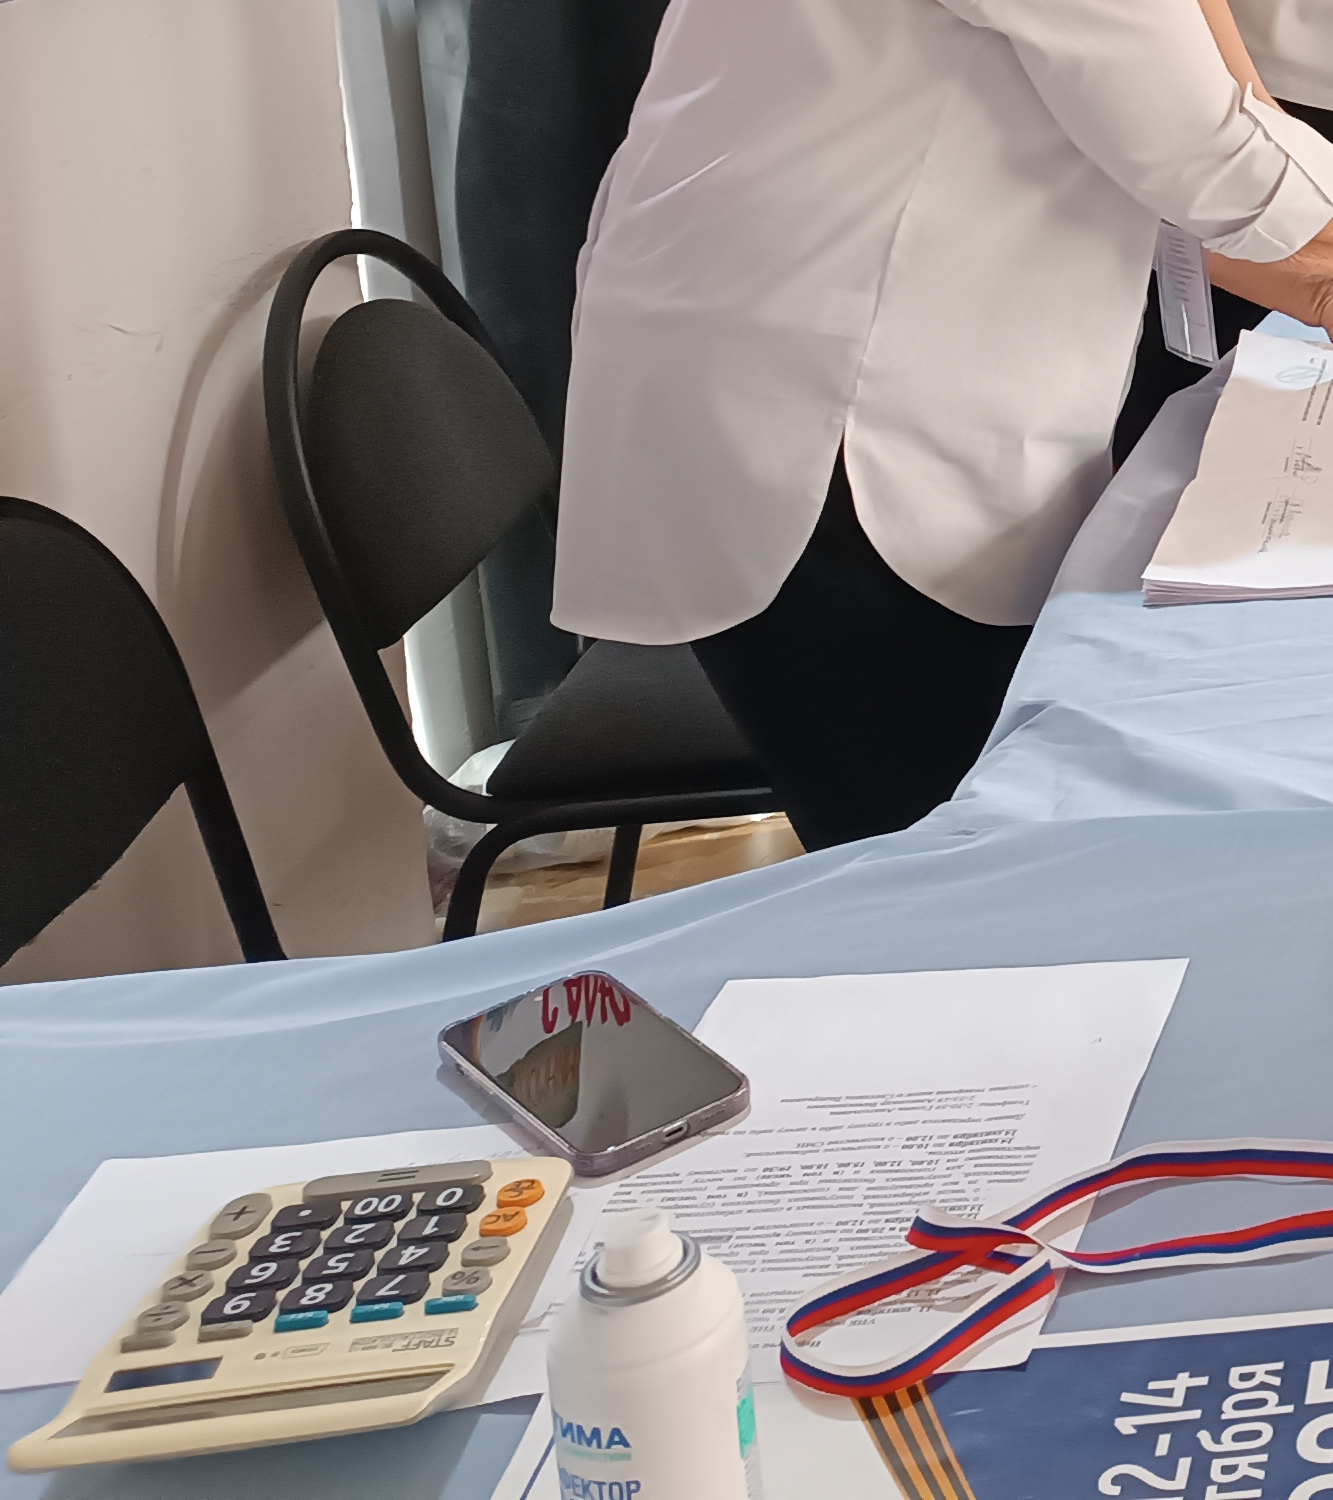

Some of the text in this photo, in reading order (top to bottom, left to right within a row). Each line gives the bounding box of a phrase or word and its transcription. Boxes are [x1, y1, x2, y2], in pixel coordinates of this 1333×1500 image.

[354, 1194, 402, 1215] 00
[344, 1223, 372, 1245] 2
[421, 1214, 439, 1236] 1
[269, 1232, 297, 1254] 3
[245, 1245, 428, 1284] 4 5 6
[299, 1283, 333, 1305] 8
[375, 1275, 404, 1298] 7
[223, 1293, 256, 1315] 9
[392, 1335, 457, 1352] STAFF
[1098, 1371, 1210, 1500] 2-14
